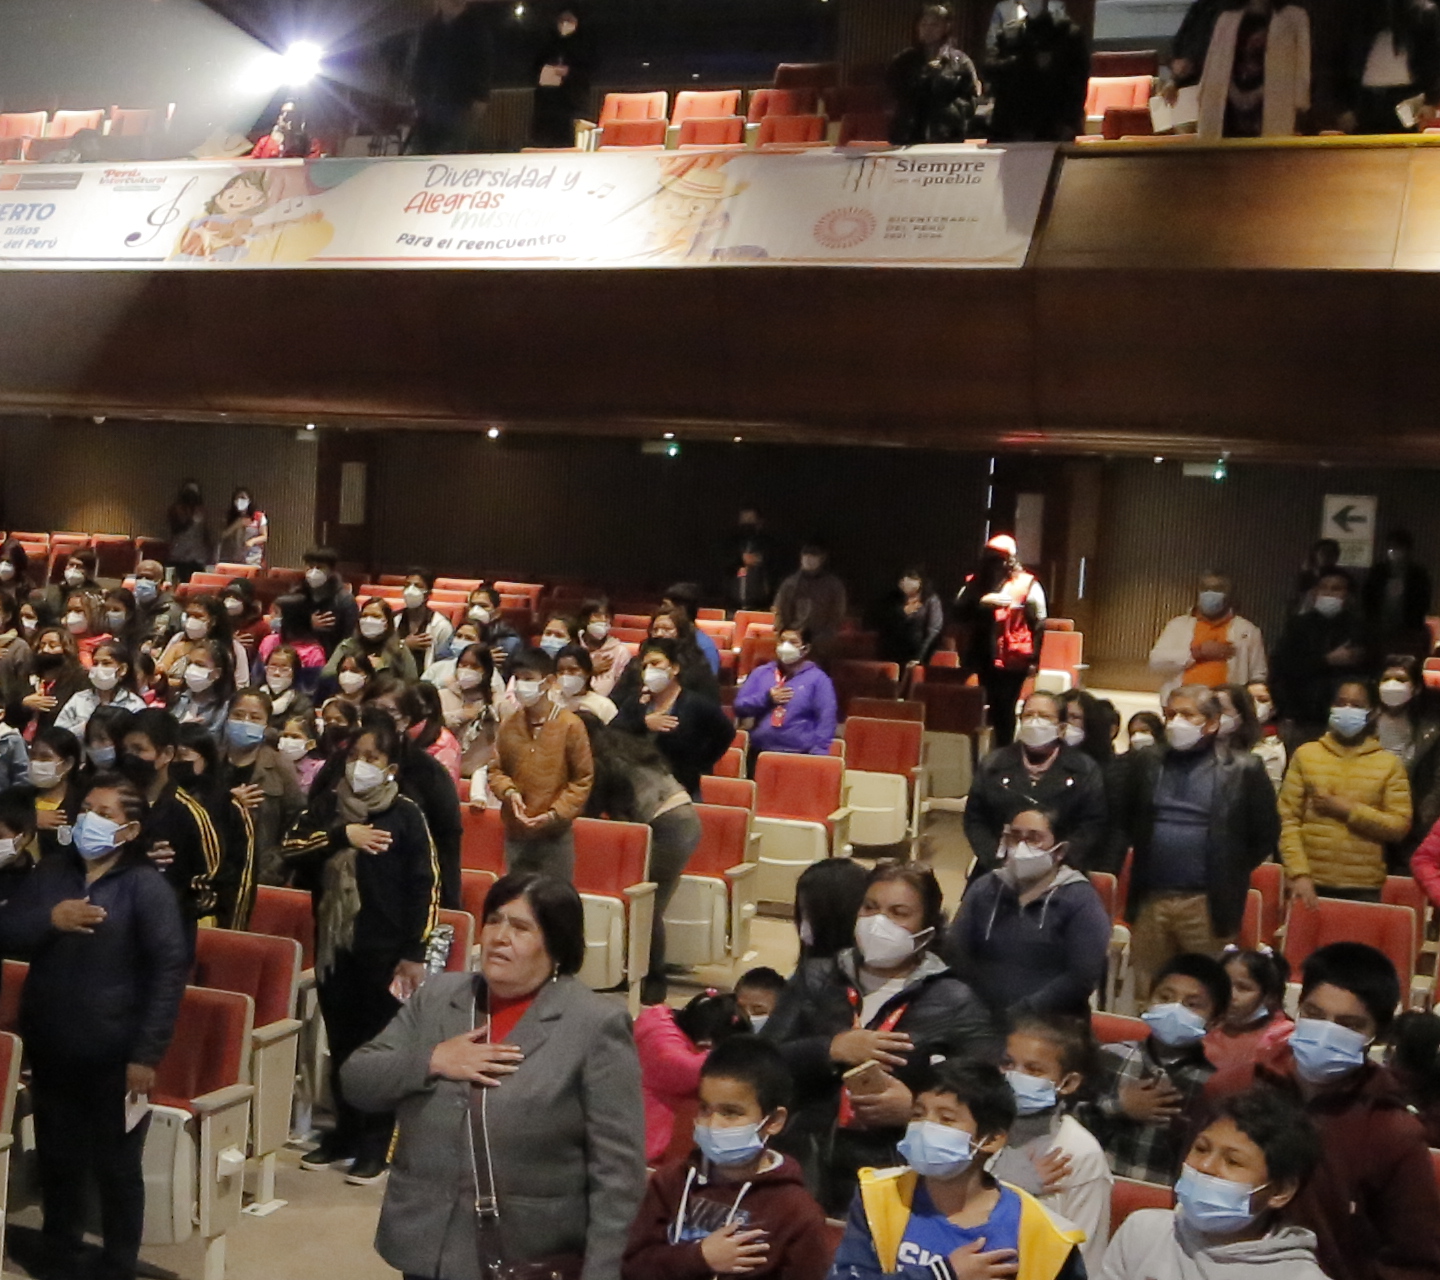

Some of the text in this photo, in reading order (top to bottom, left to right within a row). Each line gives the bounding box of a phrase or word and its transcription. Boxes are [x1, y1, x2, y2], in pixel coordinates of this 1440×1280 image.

[894, 159, 986, 175] Siempre
[424, 163, 582, 192] Diversidad y
[922, 174, 982, 187] pueblo
[3, 223, 41, 236] niños
[3, 237, 24, 249] del
[26, 235, 58, 249] Perú
[436, 237, 453, 250] el
[455, 233, 567, 251] reencuentro
